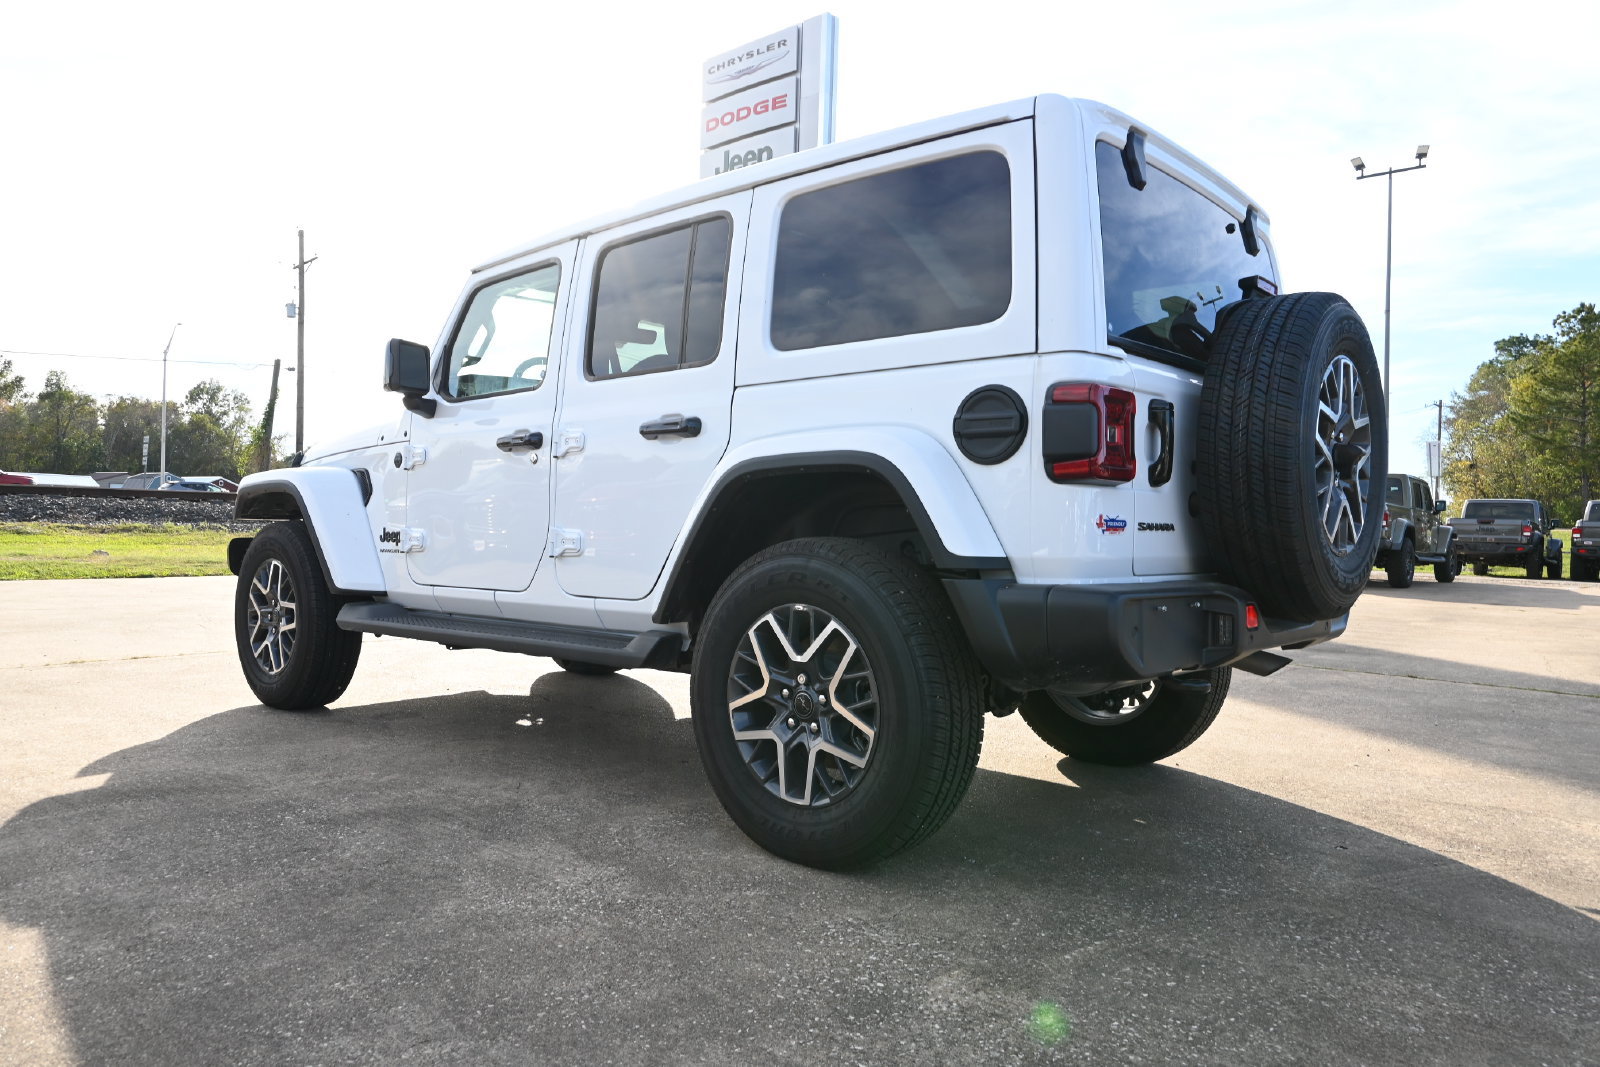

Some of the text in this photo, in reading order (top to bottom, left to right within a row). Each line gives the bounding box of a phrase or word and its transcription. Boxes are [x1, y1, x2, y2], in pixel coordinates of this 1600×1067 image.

[707, 38, 788, 75] CHRYSLER
[705, 93, 788, 132] DODGE
[379, 527, 401, 546] Jeep
[1137, 522, 1175, 532] SAHARA
